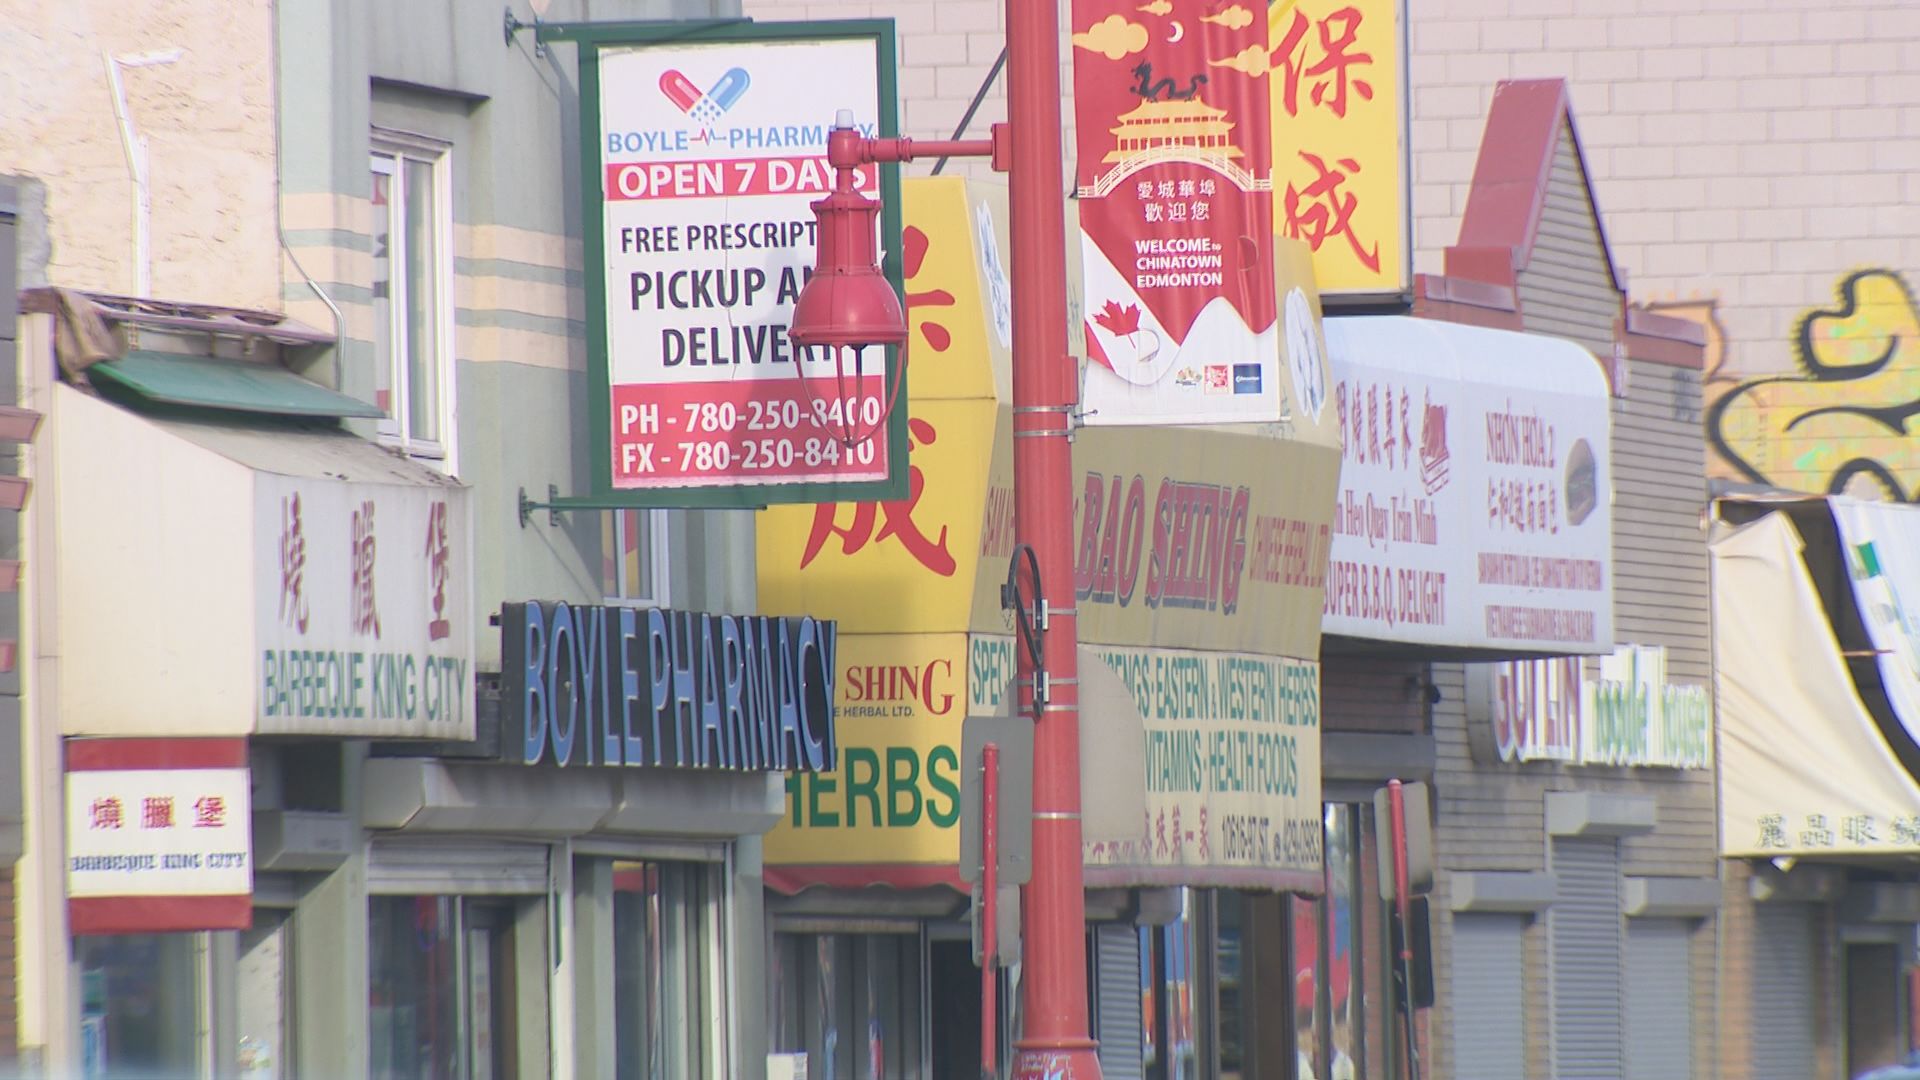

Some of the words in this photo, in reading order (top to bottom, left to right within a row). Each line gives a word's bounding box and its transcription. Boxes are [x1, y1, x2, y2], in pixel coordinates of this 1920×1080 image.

[607, 130, 689, 153] BOYLE
[729, 123, 875, 149] PHARMY
[617, 162, 724, 198] OPEN
[734, 162, 757, 193] 7
[1144, 200, 1210, 223] 歡迎您
[620, 225, 680, 253] FREE
[686, 220, 818, 251] PRESCRIPT
[1135, 238, 1211, 254] WELCOME
[1136, 255, 1222, 270] CHINATOWN
[1136, 272, 1223, 288] EDMONTON
[630, 266, 766, 311] PICKUP
[620, 403, 660, 434] PH
[683, 396, 880, 433] 780-250-8400
[621, 442, 655, 473] FX
[677, 437, 875, 472] 780-250-8410
[1074, 470, 1146, 608] BAO
[1144, 475, 1251, 617] SHING
[1398, 568, 1446, 626] DELIGHT
[262, 649, 366, 719] BARBEQUE
[371, 652, 417, 720] KING
[423, 653, 467, 723] CITY
[523, 600, 643, 768] BOYLE
[647, 606, 838, 772] PHARMACY
[844, 658, 955, 716] SHING
[1155, 656, 1209, 721] EASTERN
[1217, 657, 1276, 724] WESTERN
[1278, 662, 1318, 727] HERBS
[843, 705, 889, 717] HERBAL
[892, 705, 915, 717] LTD.
[1144, 729, 1202, 793] VITAMINS
[1208, 729, 1255, 793] HEALTH
[1257, 732, 1298, 798] FOODS
